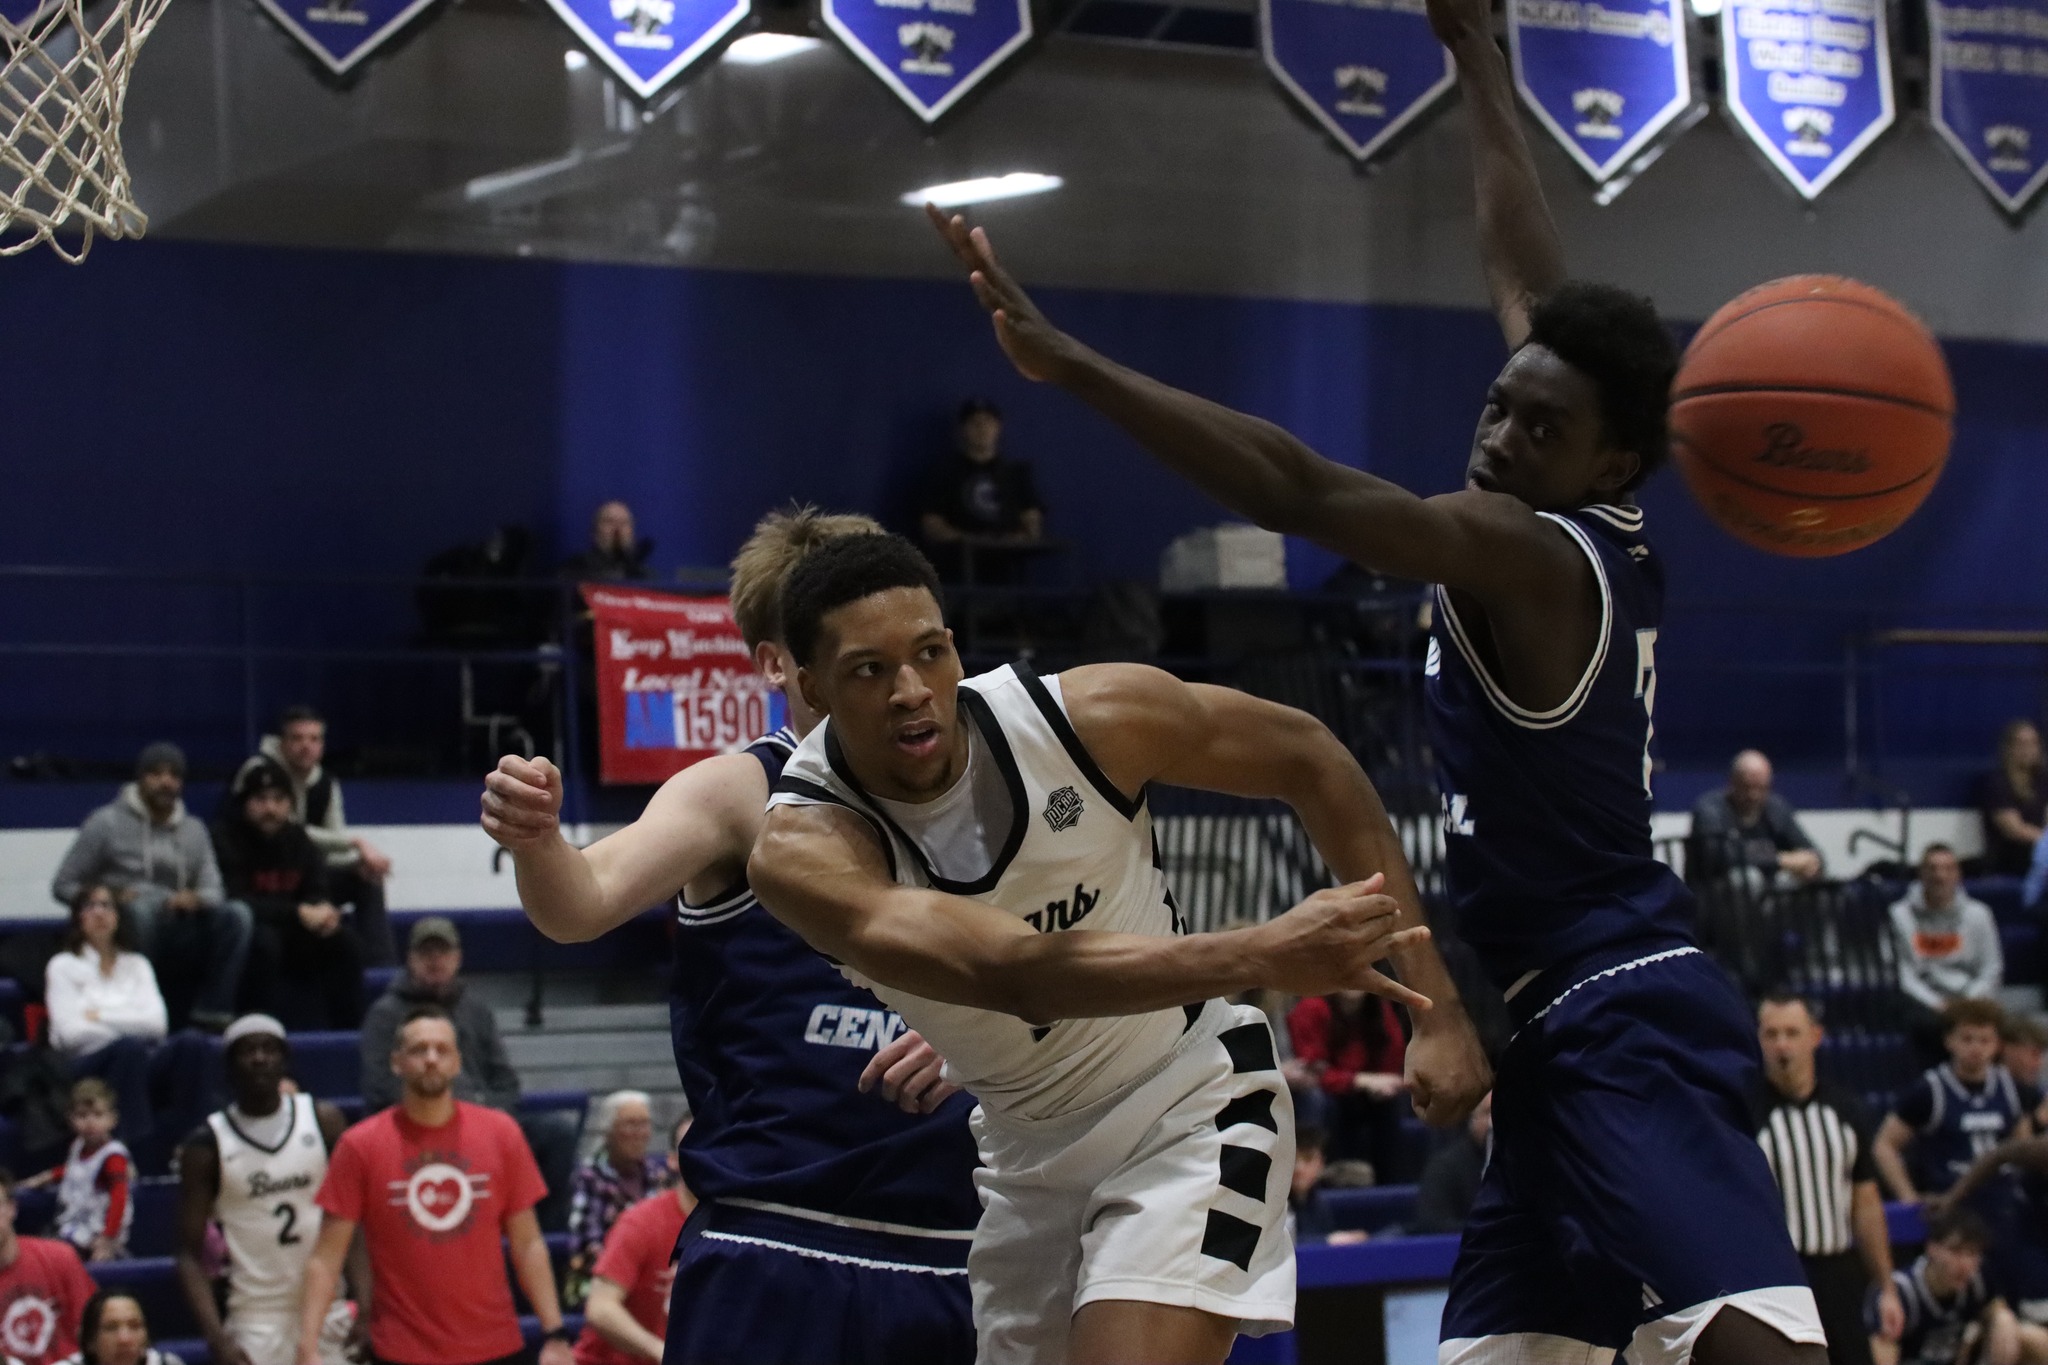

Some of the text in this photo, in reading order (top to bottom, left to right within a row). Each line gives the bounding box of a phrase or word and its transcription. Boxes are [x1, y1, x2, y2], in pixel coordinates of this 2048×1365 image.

[680, 694, 764, 744] 1590
[1022, 883, 1101, 934] ars
[803, 1003, 907, 1051] CEN
[273, 1202, 301, 1246] 2
